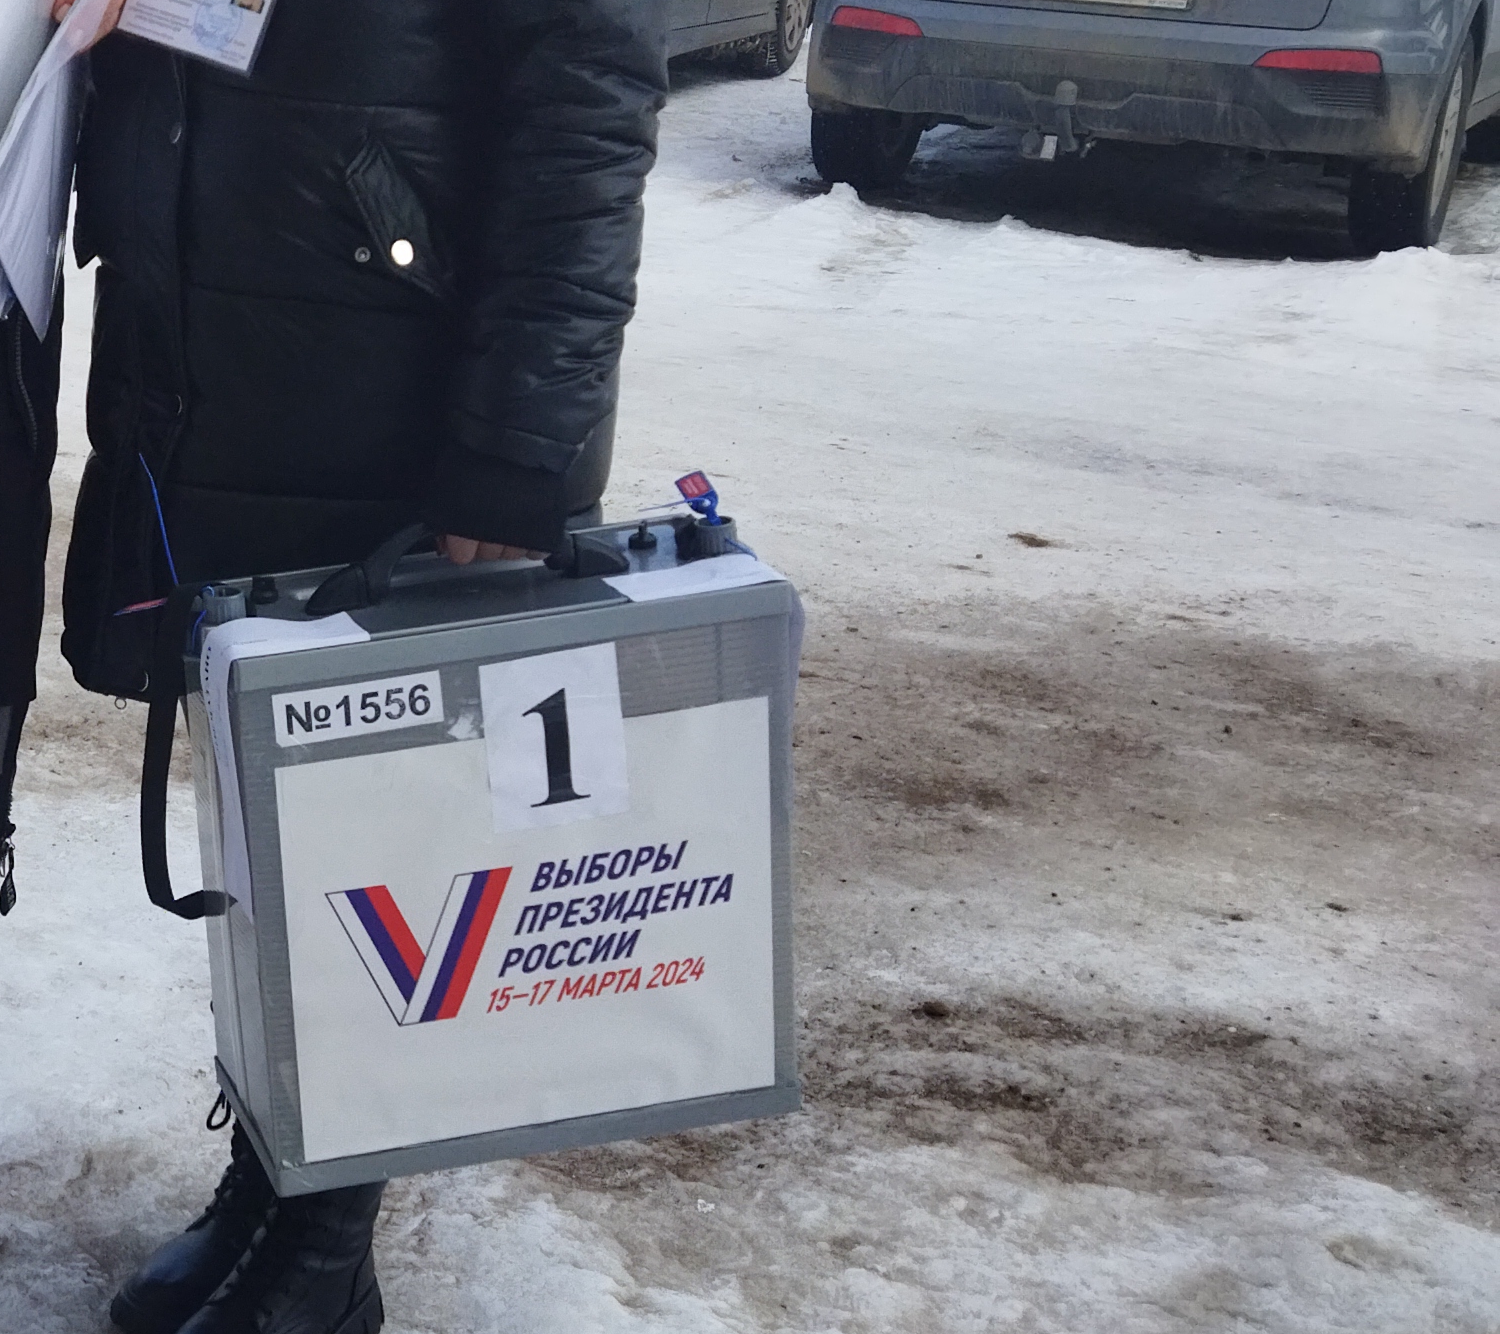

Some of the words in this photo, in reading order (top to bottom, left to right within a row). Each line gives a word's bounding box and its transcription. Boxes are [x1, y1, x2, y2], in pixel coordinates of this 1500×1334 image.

[284, 683, 431, 736] №1556
[521, 687, 592, 809] 1
[529, 839, 689, 893] ВЫБОРЫ
[513, 873, 735, 936] ПРЕЗИДЕНТА
[498, 928, 642, 979] РОССИИ
[556, 966, 643, 1003] МАРТА
[645, 955, 706, 990] 2024
